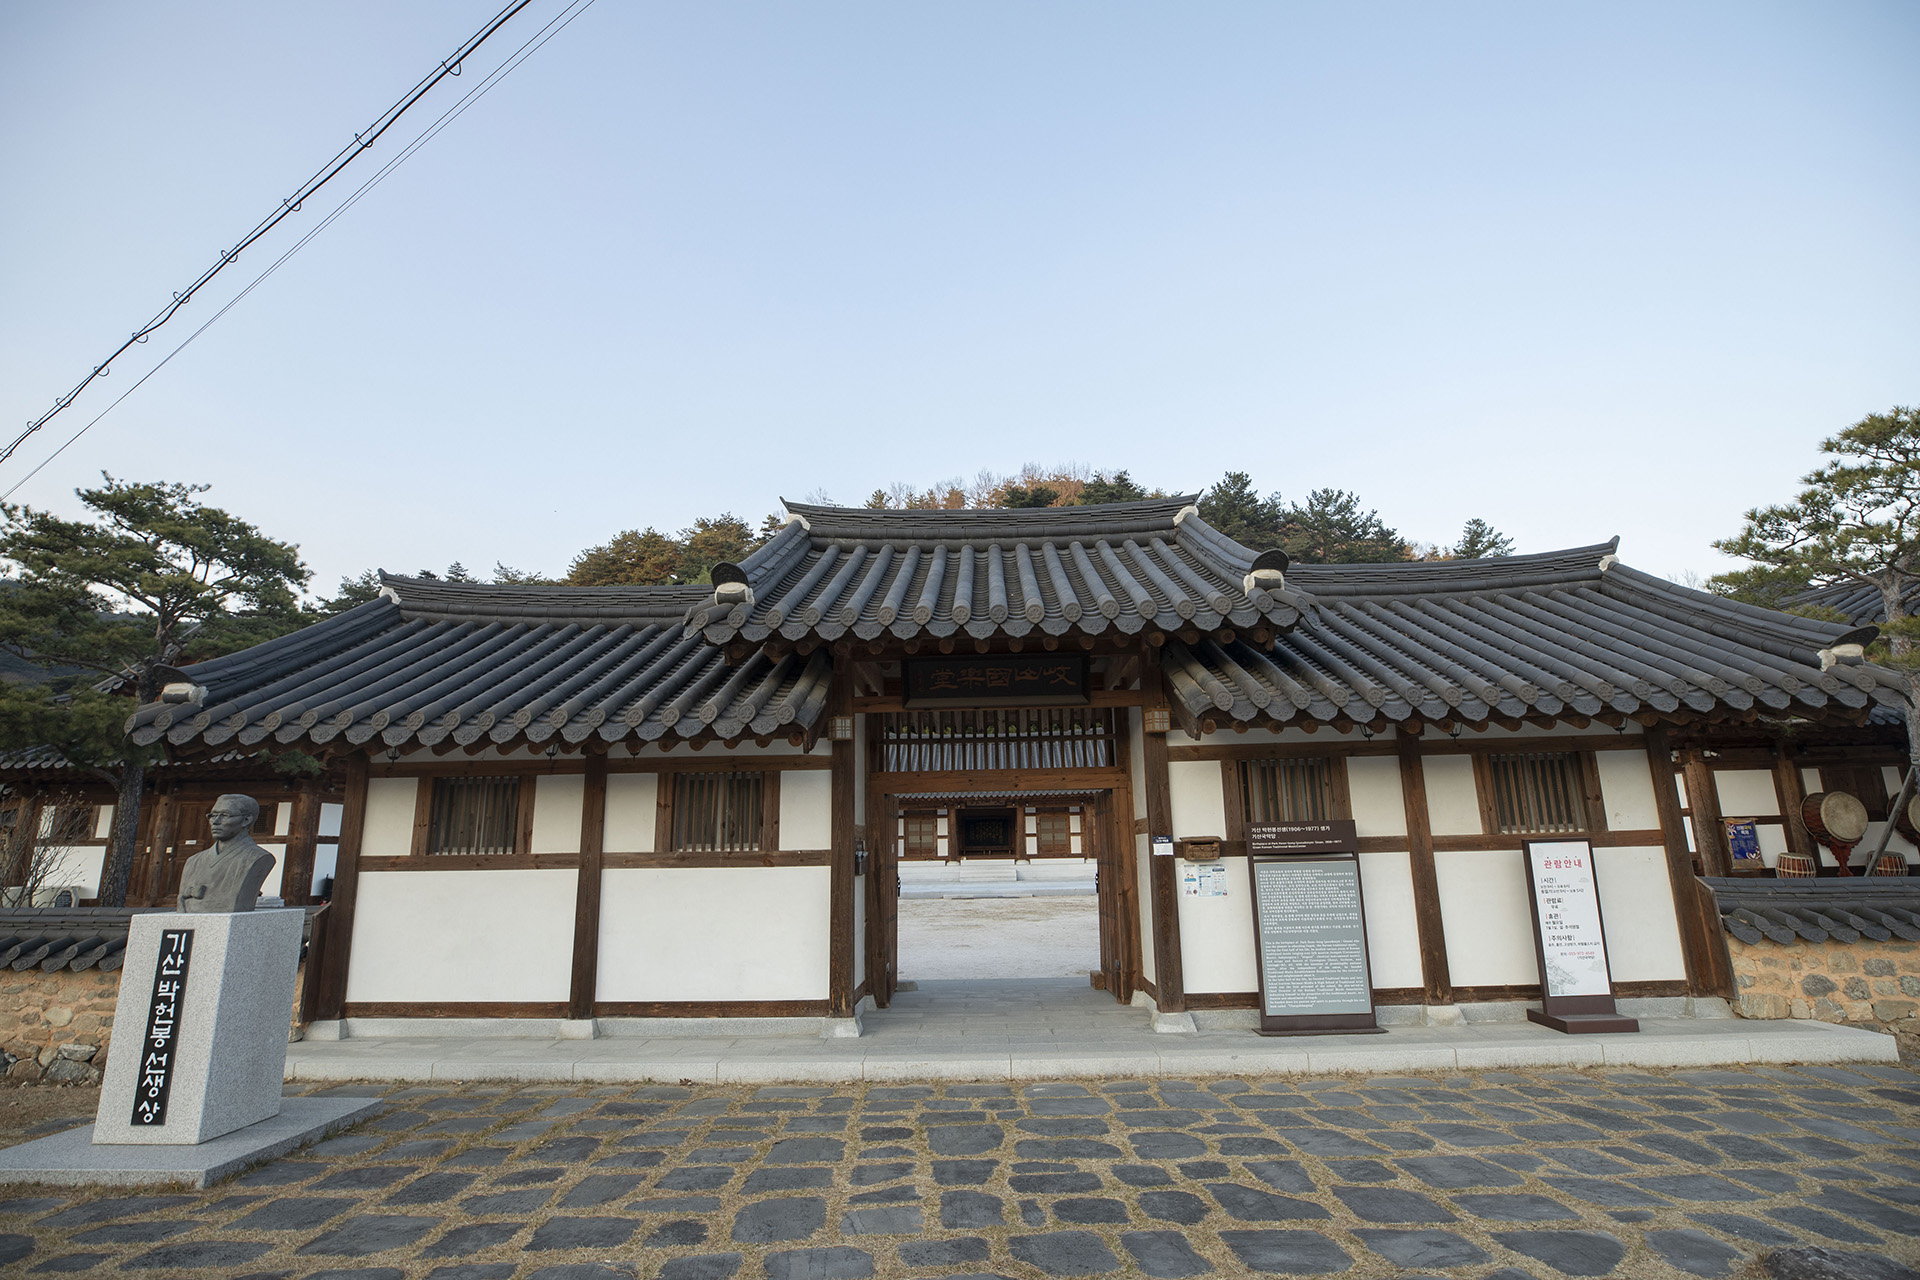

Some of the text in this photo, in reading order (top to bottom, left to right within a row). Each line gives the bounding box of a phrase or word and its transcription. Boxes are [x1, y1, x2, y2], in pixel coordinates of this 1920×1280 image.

[1544, 858, 1583, 869] 관람안내
[138, 932, 187, 1124] 기산 박헌봉 선생 상
